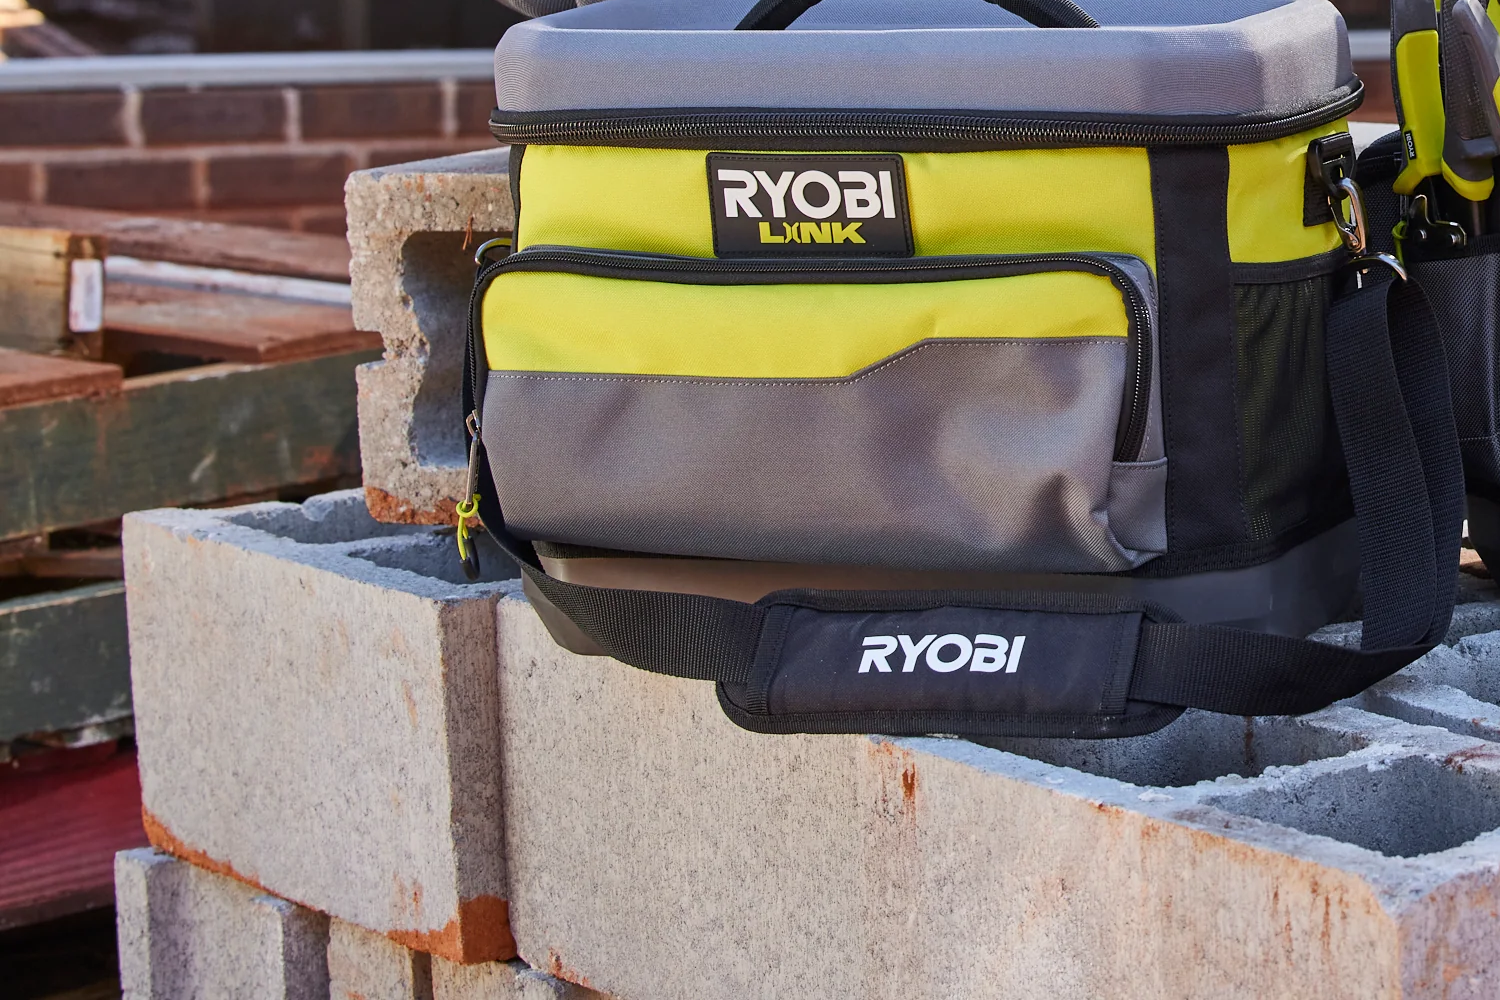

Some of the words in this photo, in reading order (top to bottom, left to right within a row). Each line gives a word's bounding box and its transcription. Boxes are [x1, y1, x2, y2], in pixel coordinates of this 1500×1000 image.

[1405, 132, 1416, 158] RYOBI
[717, 168, 896, 220] RYOBI
[758, 221, 867, 244] LINK
[857, 633, 1027, 674] RYOBI
